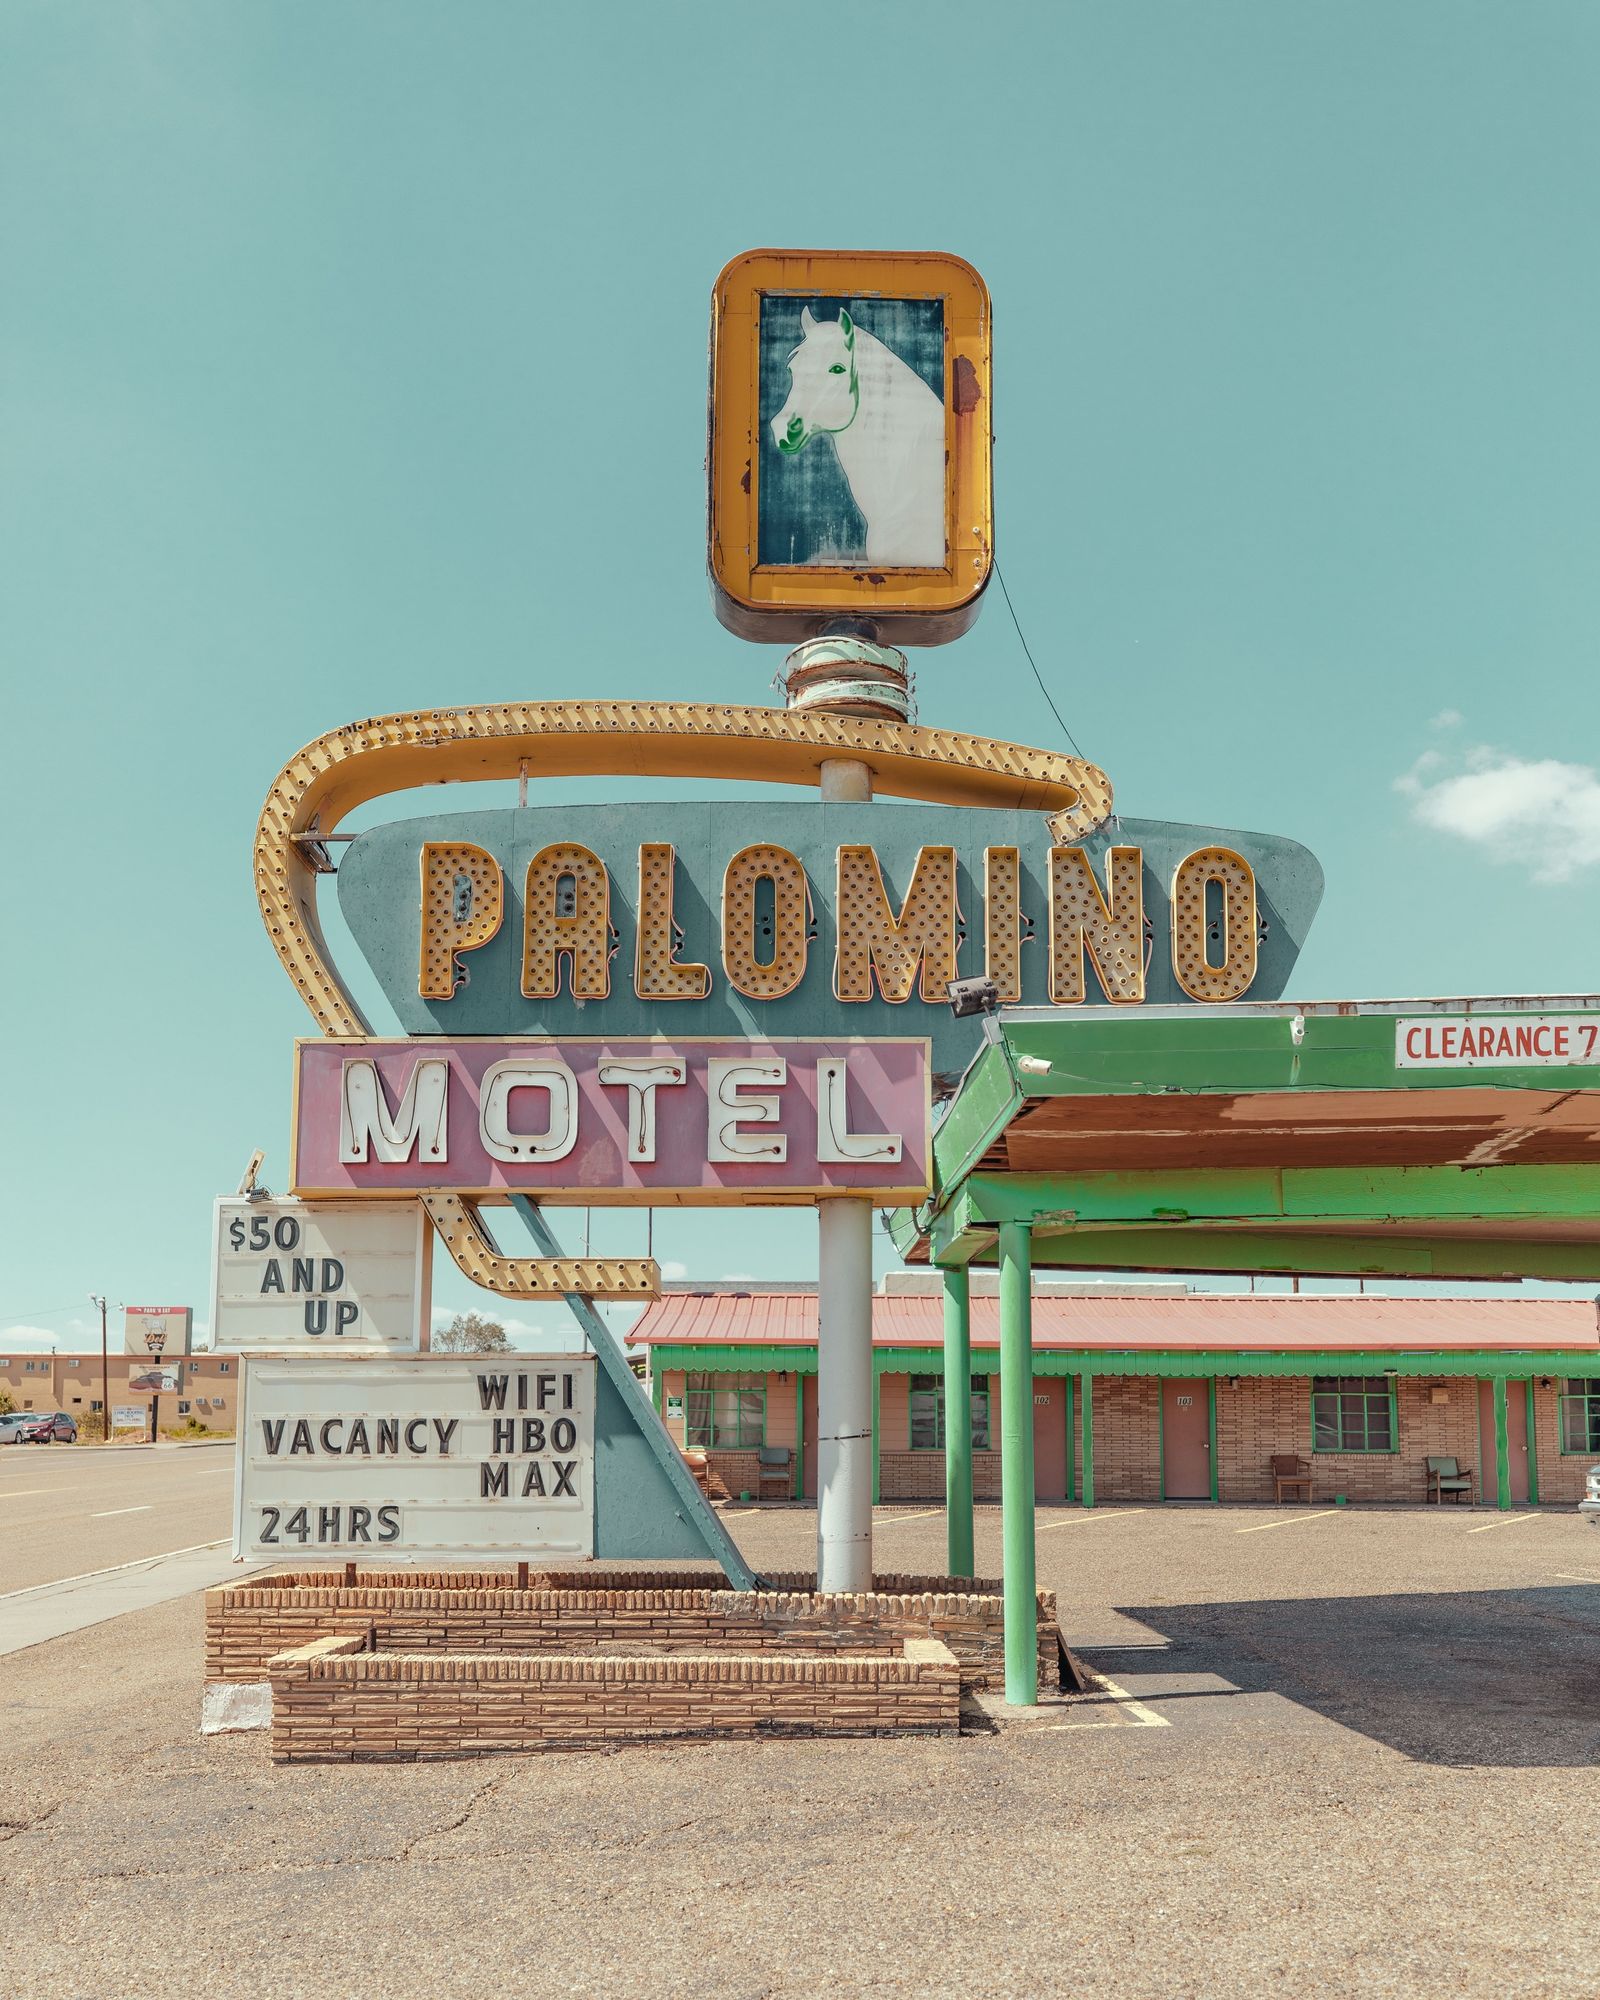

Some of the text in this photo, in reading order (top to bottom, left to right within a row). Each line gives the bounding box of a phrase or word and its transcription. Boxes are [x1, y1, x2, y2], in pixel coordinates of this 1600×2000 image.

[418, 842, 1257, 1004] PALOMINO
[1407, 1025, 1599, 1058] CLEARANCE 7
[339, 1057, 902, 1164] MOTEL
[229, 1216, 300, 1251] $50
[260, 1258, 345, 1294] AND
[304, 1300, 359, 1336] UP
[477, 1374, 573, 1410] WIFI
[1036, 1396, 1049, 1404] 102
[1179, 1397, 1192, 1405] 103
[261, 1417, 577, 1455] VACANCY HBO
[480, 1461, 578, 1497] MAX
[259, 1505, 400, 1544] 24HRS
